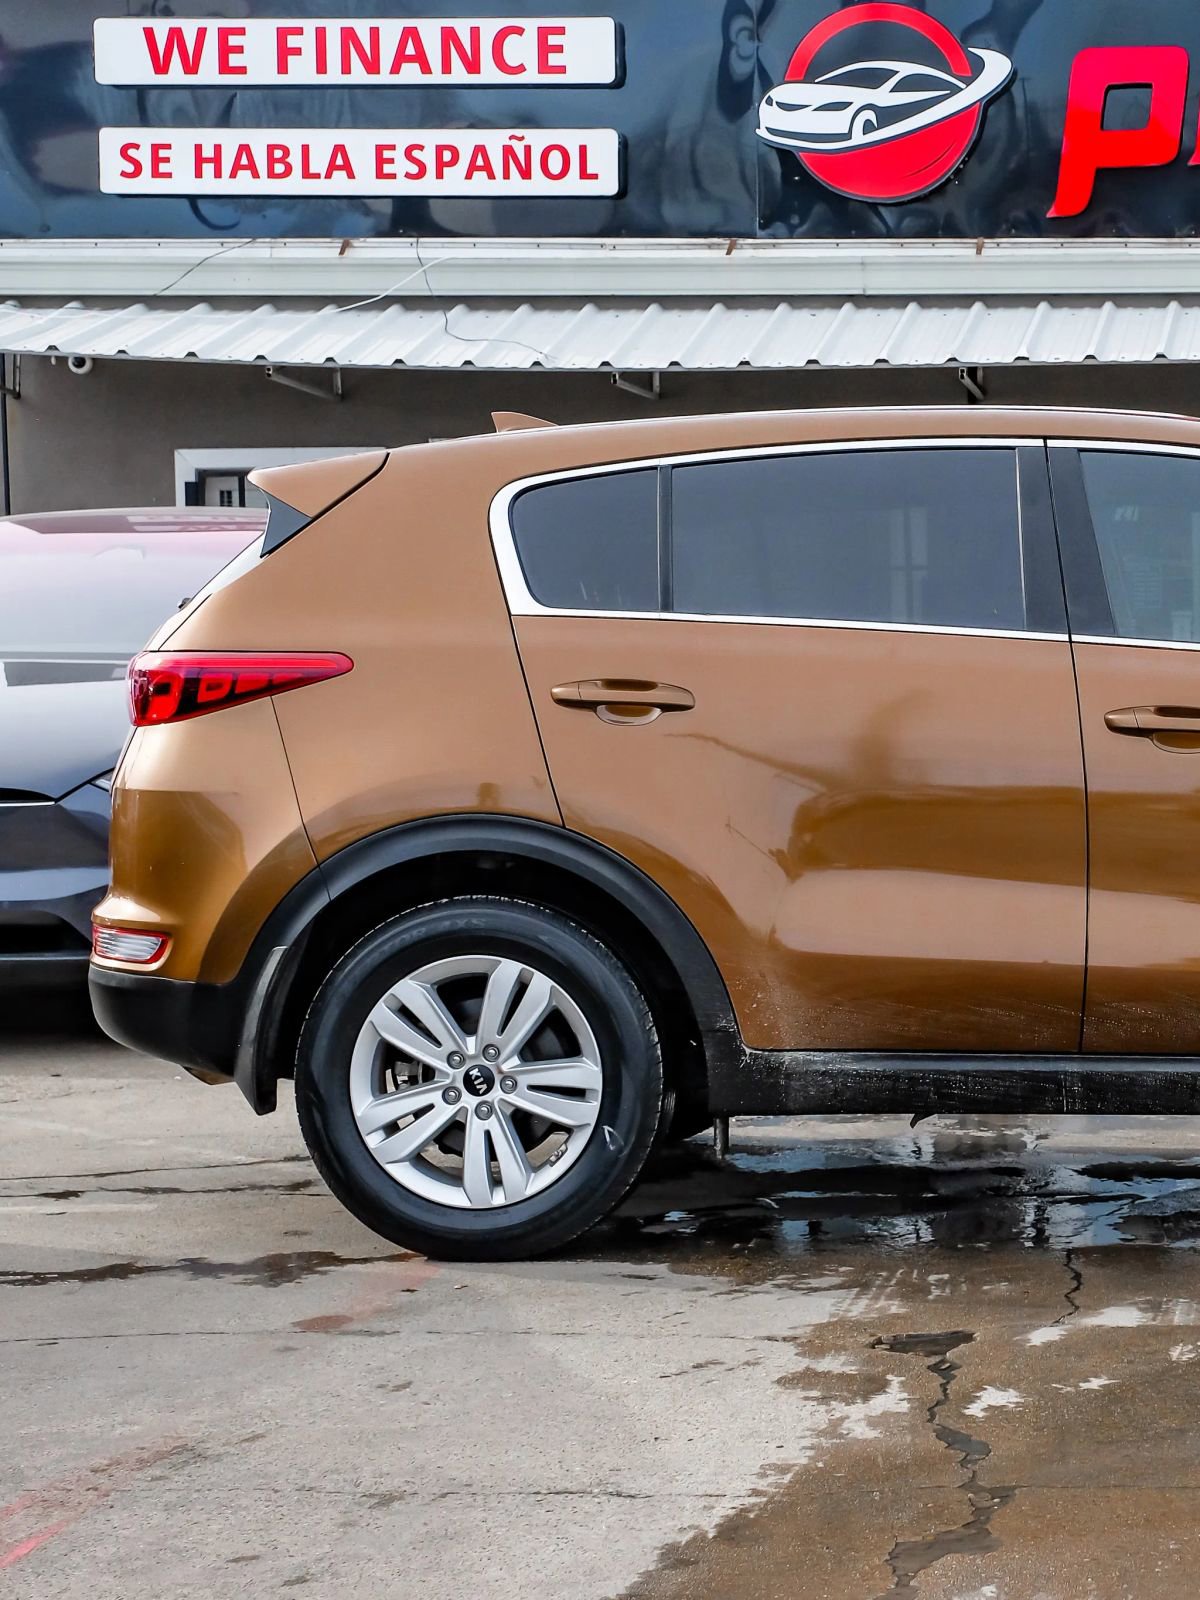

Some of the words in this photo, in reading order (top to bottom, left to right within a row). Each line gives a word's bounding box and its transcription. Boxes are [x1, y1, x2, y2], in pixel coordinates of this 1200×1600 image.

[142, 26, 248, 75] WE
[276, 25, 567, 75] FINANCE
[119, 143, 173, 180] SE
[194, 143, 356, 180] HABLA
[375, 134, 599, 181] ESPAÑOL
[468, 1067, 488, 1095] KIA
